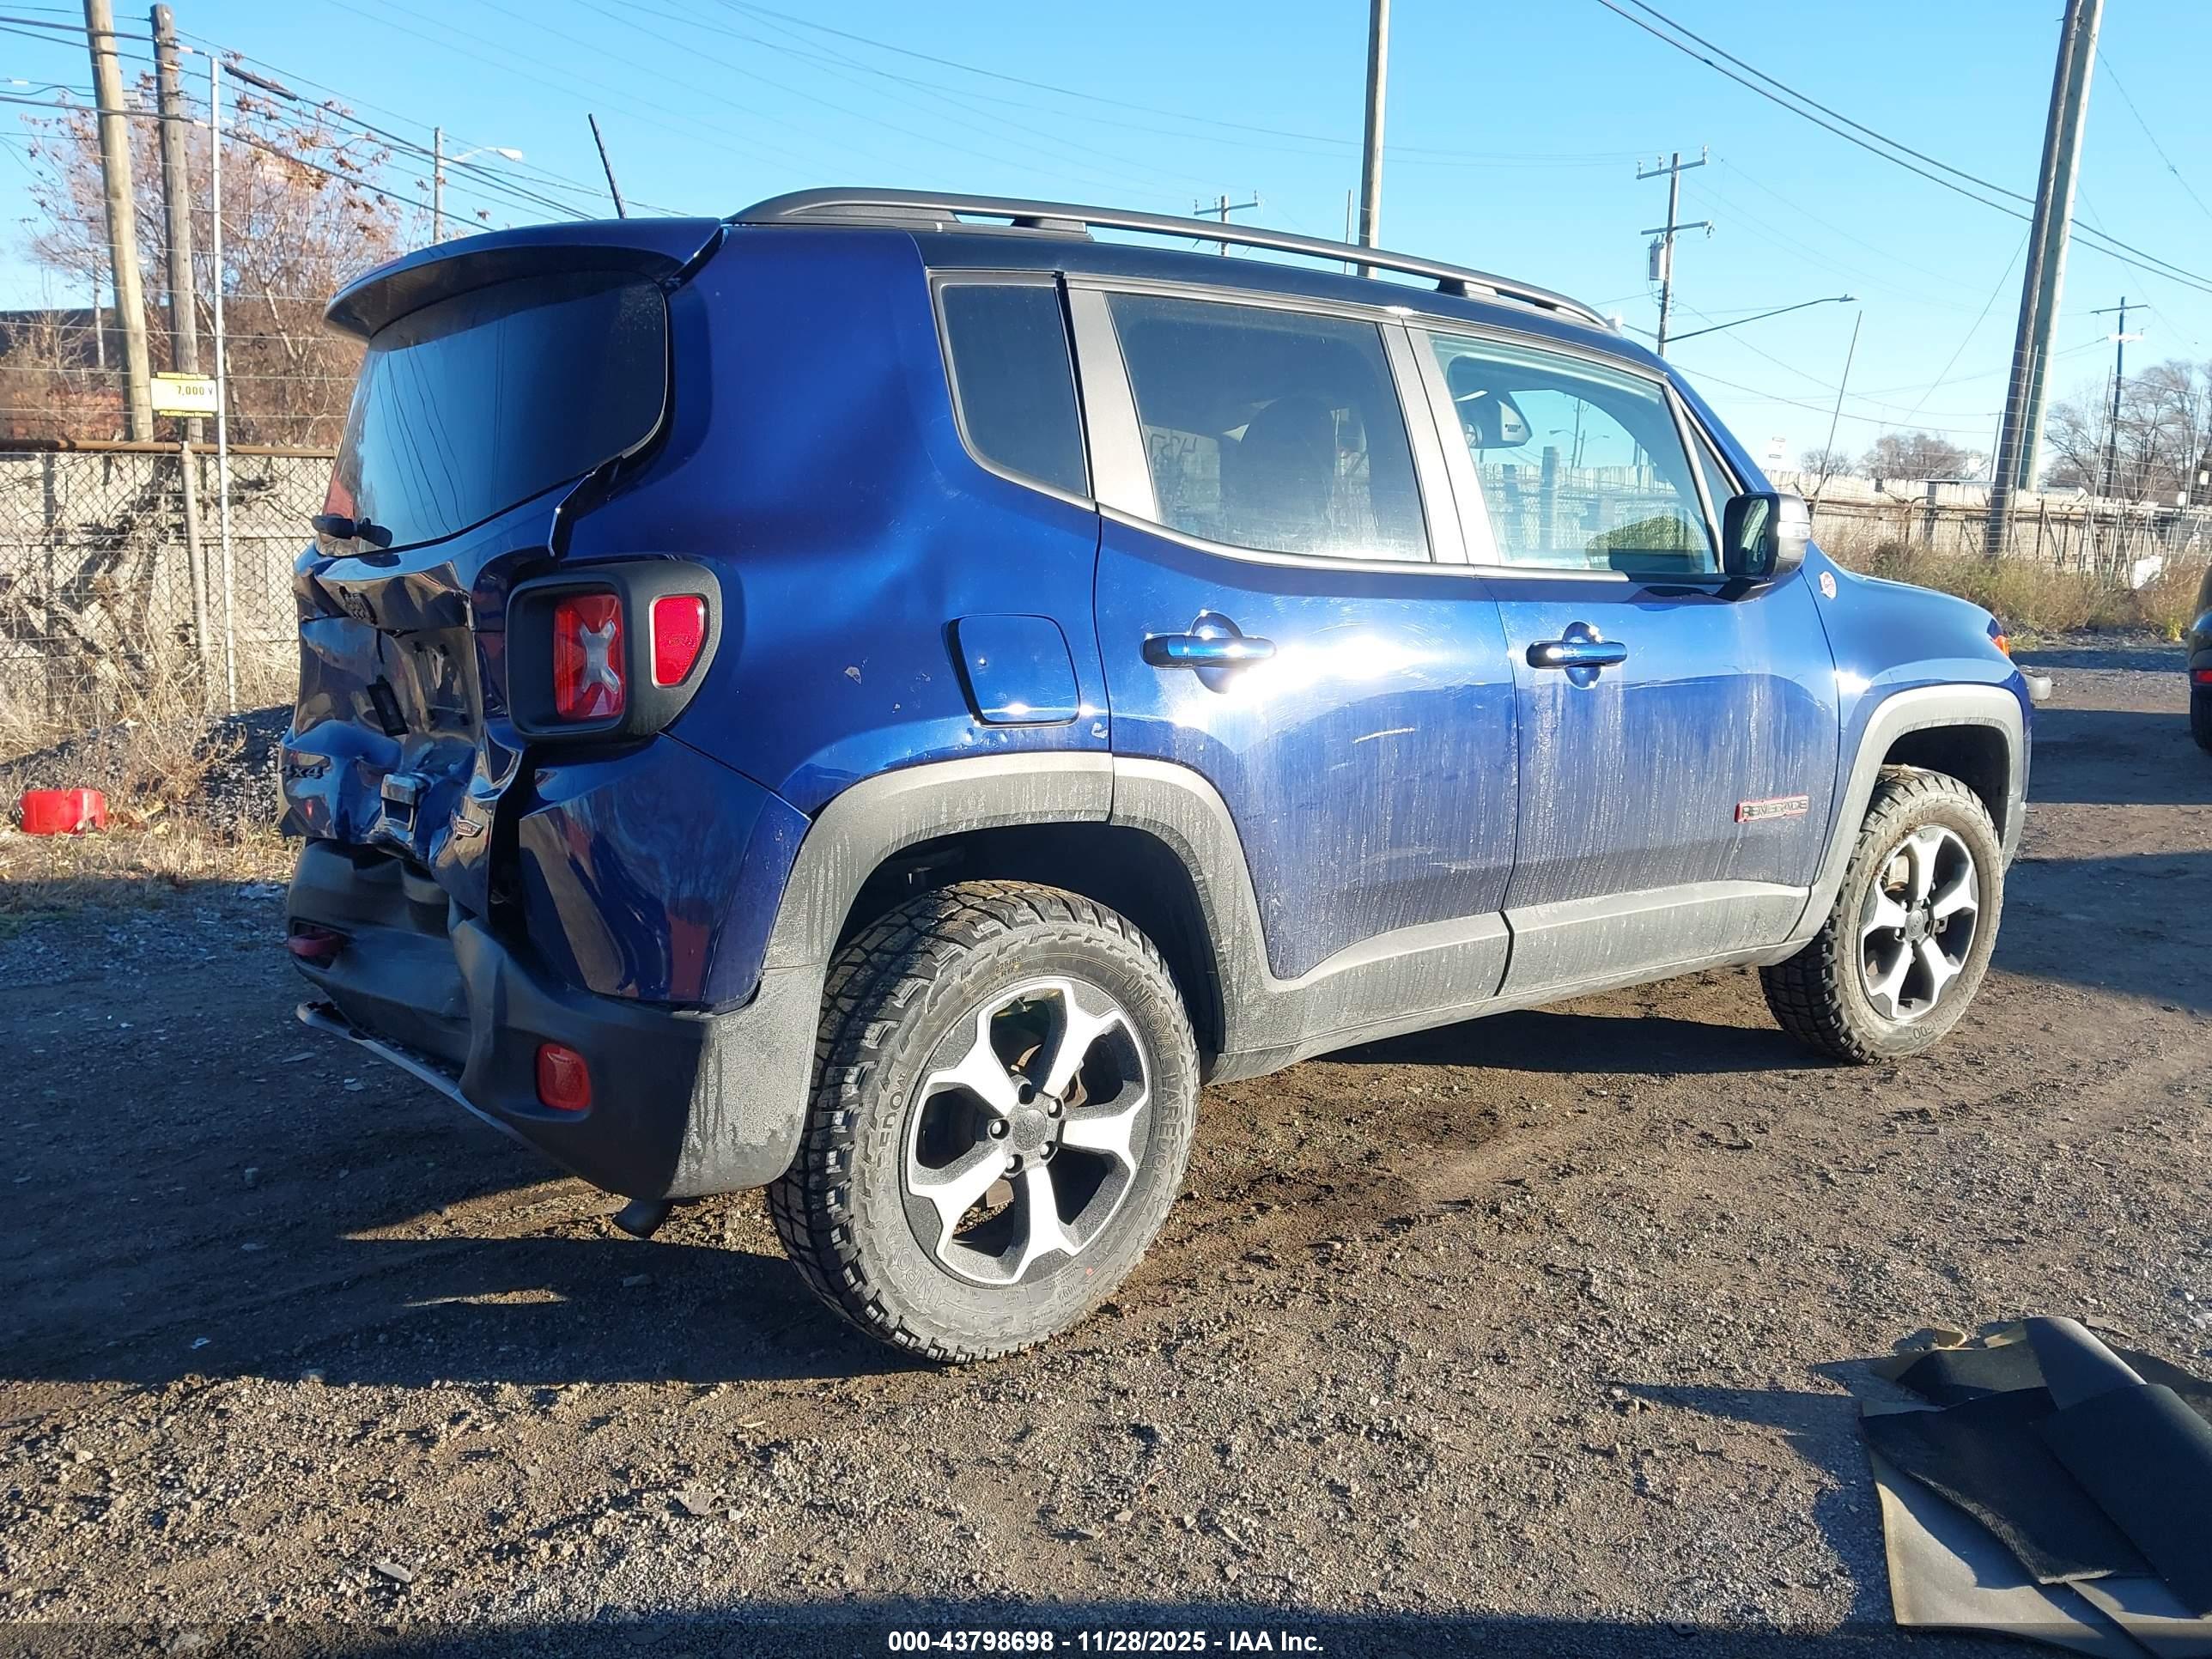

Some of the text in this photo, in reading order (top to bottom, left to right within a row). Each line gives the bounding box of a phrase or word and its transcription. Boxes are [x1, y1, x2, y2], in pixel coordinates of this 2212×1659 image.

[177, 385, 204, 396] 7,000
[280, 763, 324, 779] 4x4
[1121, 974, 1177, 1068] UNIROYAL
[1151, 1072, 1181, 1172] LAREDO
